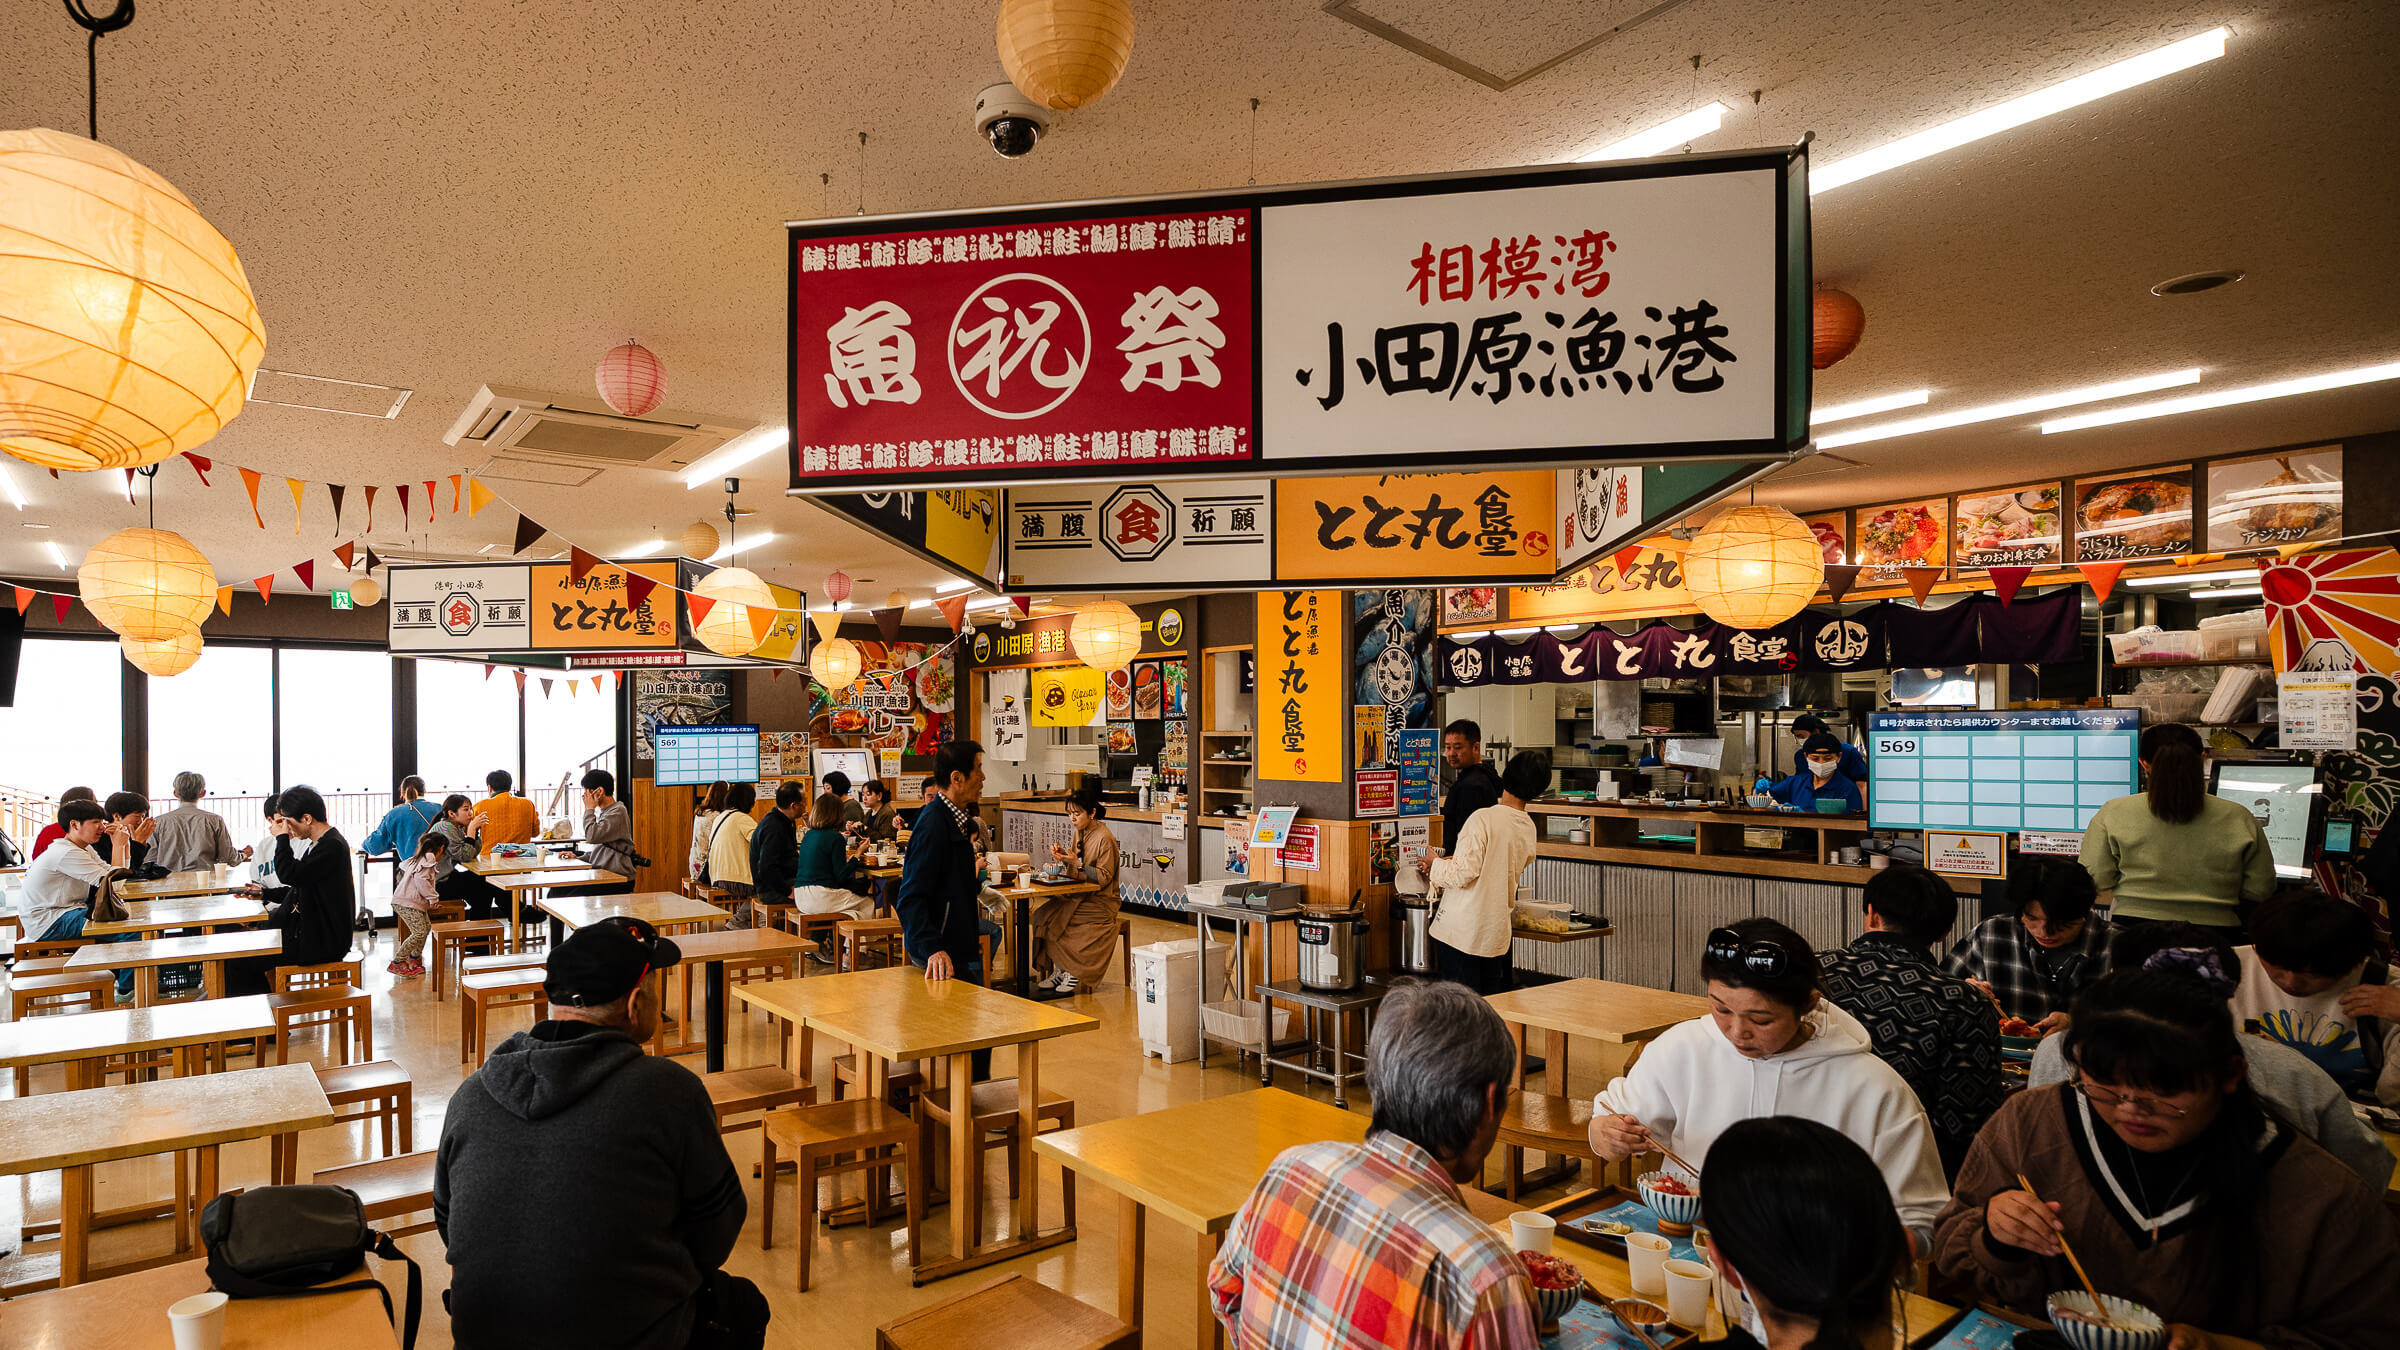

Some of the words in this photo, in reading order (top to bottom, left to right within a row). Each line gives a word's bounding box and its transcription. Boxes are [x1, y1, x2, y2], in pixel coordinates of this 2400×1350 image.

[1407, 229, 1617, 306] 相模湾
[824, 300, 922, 408] 魚
[957, 297, 1080, 398] 祝
[1115, 285, 1226, 392] 祭
[1296, 300, 1737, 411] 小田原漁港
[1115, 499, 1160, 544] 食
[2080, 535, 2126, 549] うにうに
[2242, 527, 2308, 545] アジカツ
[1970, 549, 2048, 566] 港のお刺身定食
[2080, 541, 2187, 560] パラダイスラーメン
[448, 600, 471, 626] 食
[1306, 592, 1319, 655] 田原漁港
[1879, 716, 2124, 728] 番号が表示されたら提供カウンターまでお越しください
[1880, 740, 1915, 753] 569
